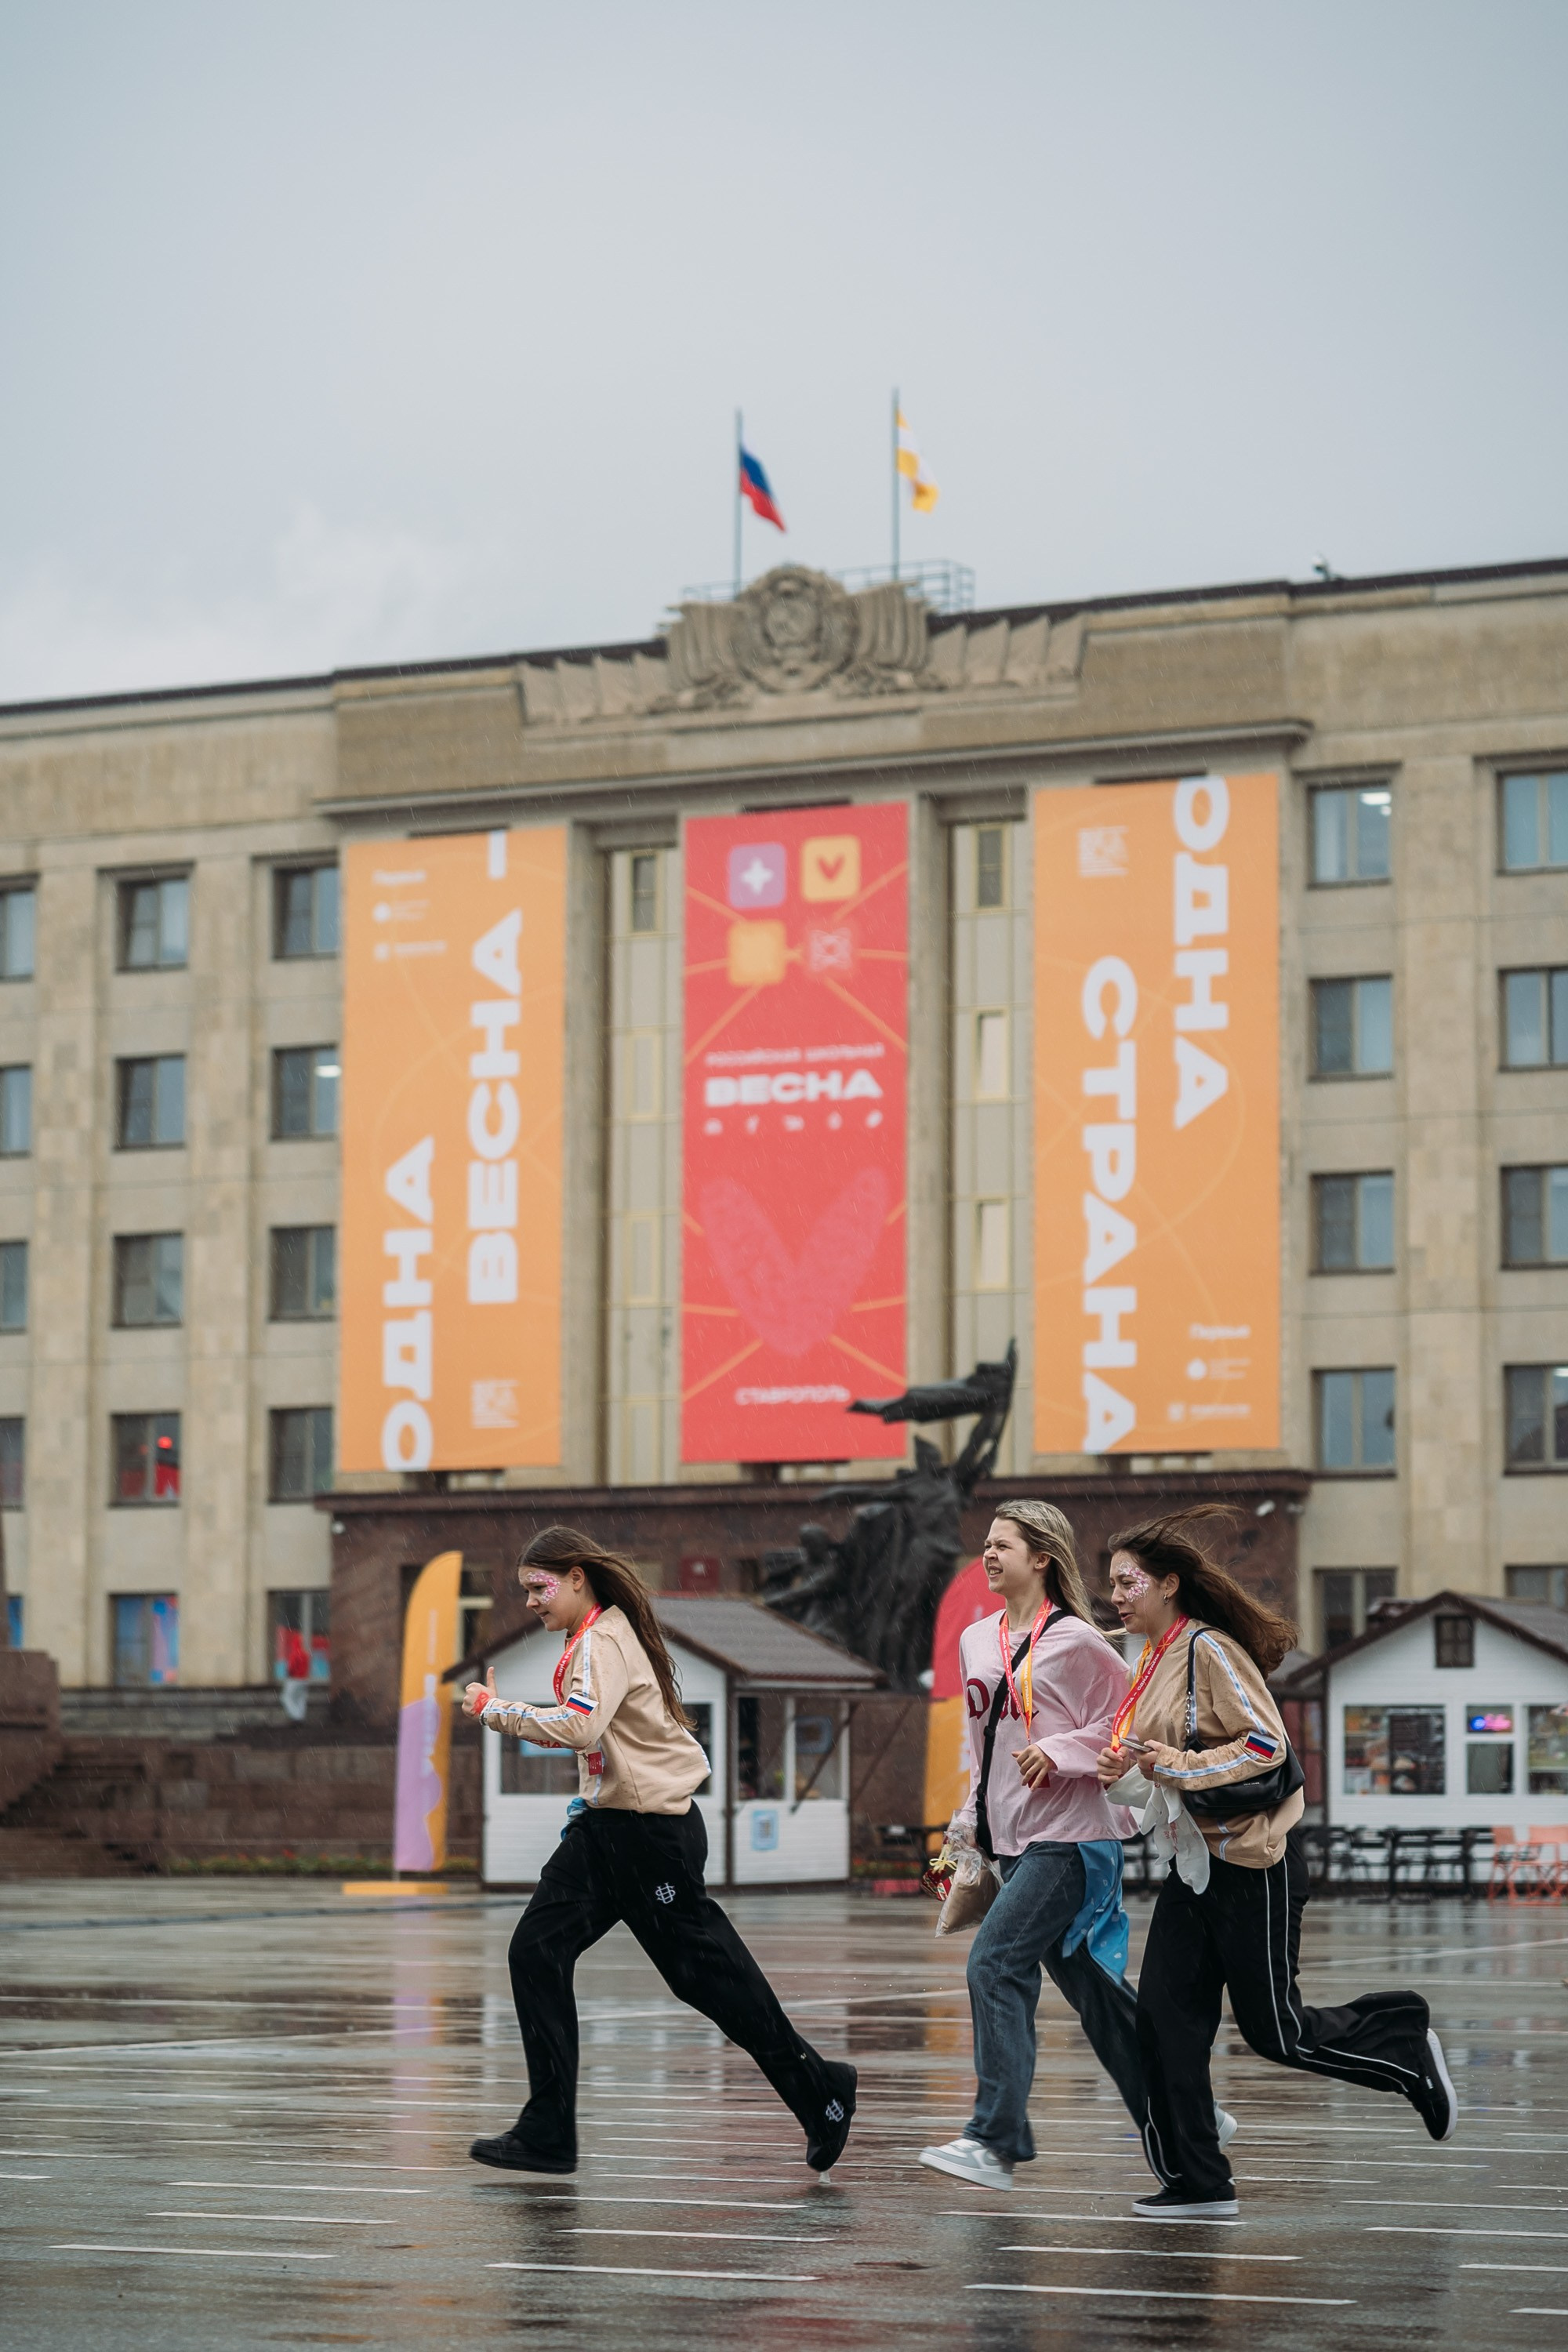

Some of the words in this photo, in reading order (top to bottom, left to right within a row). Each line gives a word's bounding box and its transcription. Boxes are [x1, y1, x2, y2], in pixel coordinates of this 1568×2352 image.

[467, 906, 522, 1304] ВЕСНА
[705, 1069, 884, 1107] ВЕСНА
[1173, 774, 1229, 1131] ОДНА
[381, 1135, 434, 1472] ОДНА
[1081, 955, 1137, 1456] СТРАНА
[1120, 1697, 1134, 1716] ВЕСНА
[1137, 1675, 1149, 1691] ОДНА
[1147, 1653, 1160, 1675] СТРАНА
